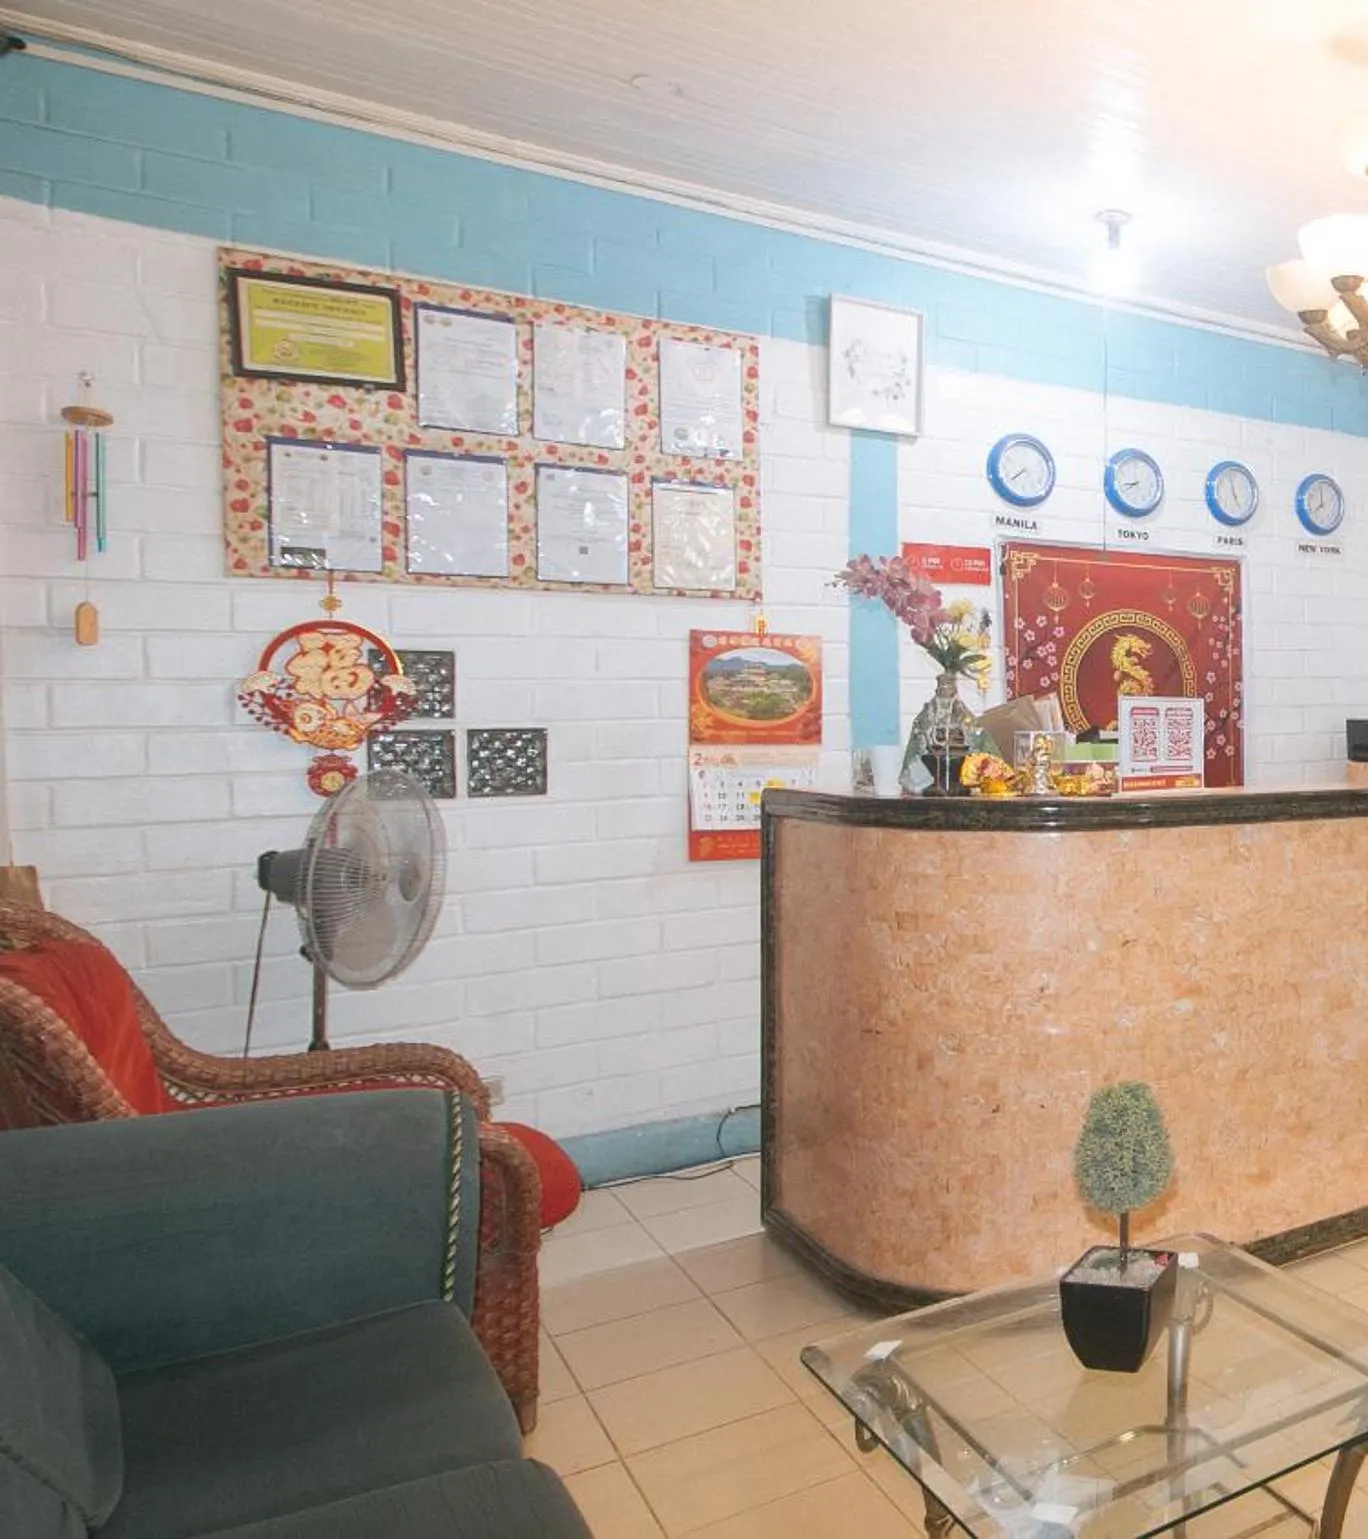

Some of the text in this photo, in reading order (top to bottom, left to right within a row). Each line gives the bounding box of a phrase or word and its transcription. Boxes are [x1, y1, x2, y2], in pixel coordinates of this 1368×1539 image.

[995, 515, 1037, 530] MANILA
[1117, 528, 1150, 541] TOKYO
[1216, 535, 1244, 546] PARIS
[1298, 544, 1342, 555] NEW YORK
